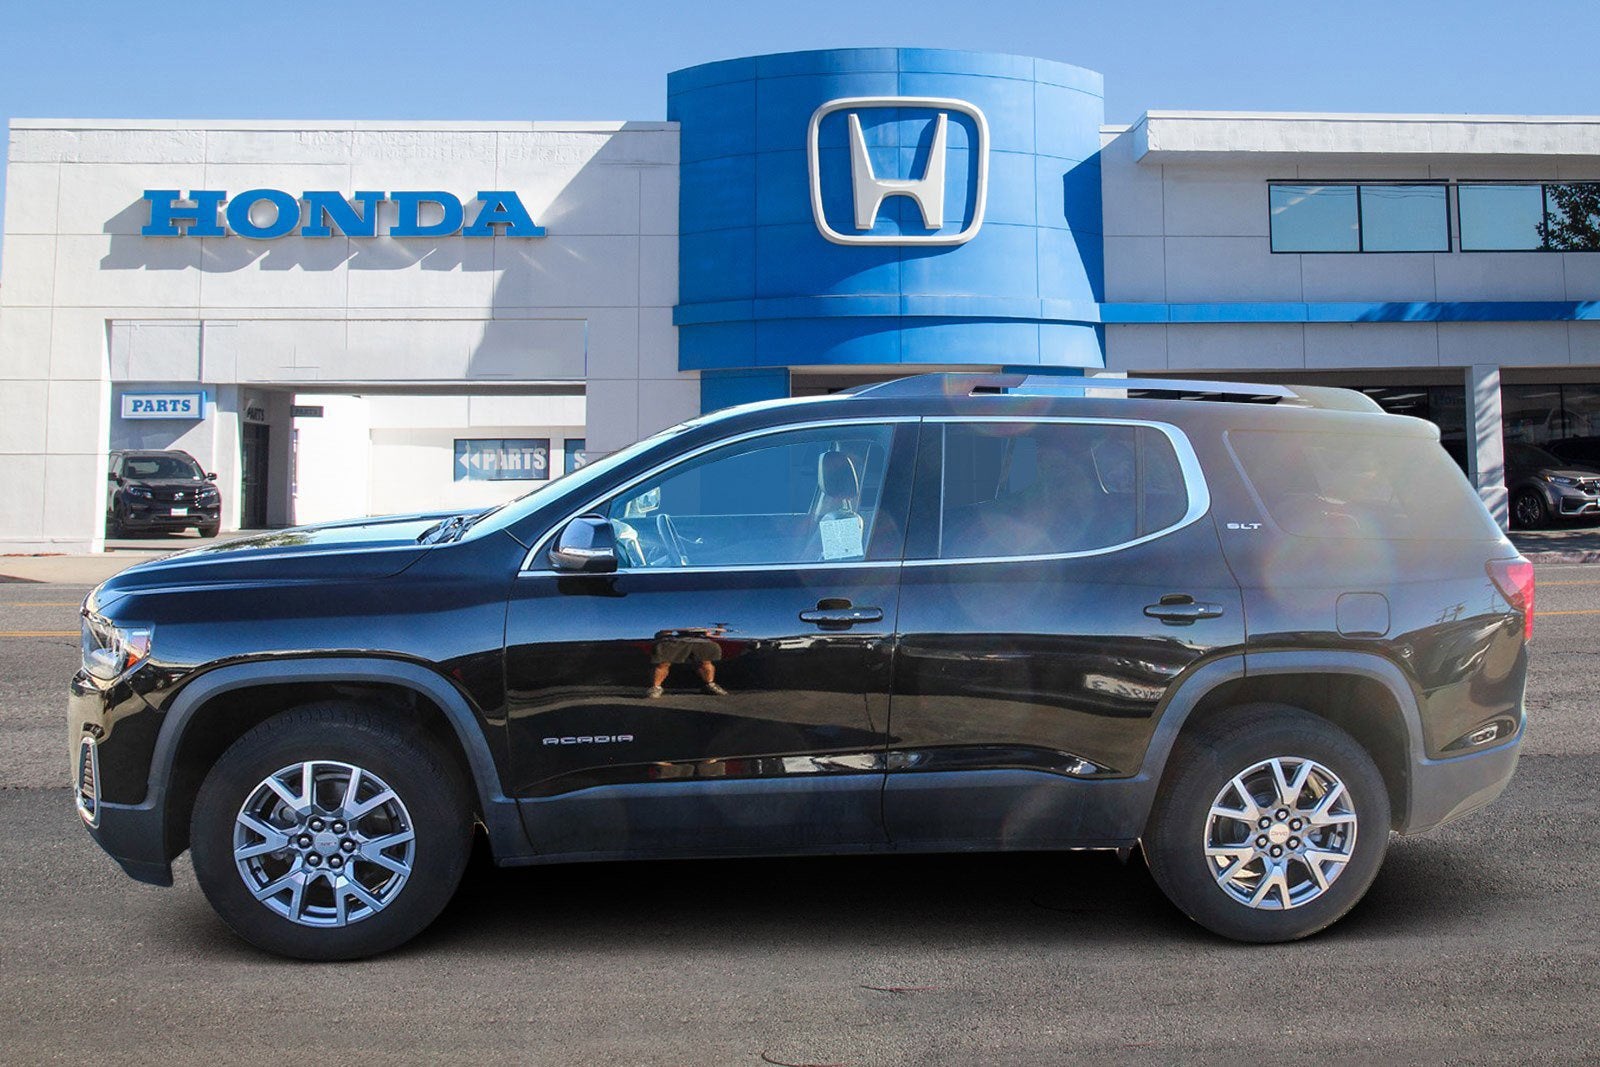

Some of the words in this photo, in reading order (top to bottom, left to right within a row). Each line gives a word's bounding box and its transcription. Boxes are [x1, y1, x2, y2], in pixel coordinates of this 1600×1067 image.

[141, 188, 548, 239] HONDA
[131, 399, 191, 412] PARTS
[482, 448, 546, 471] PARTS
[542, 734, 634, 745] ACADIA
